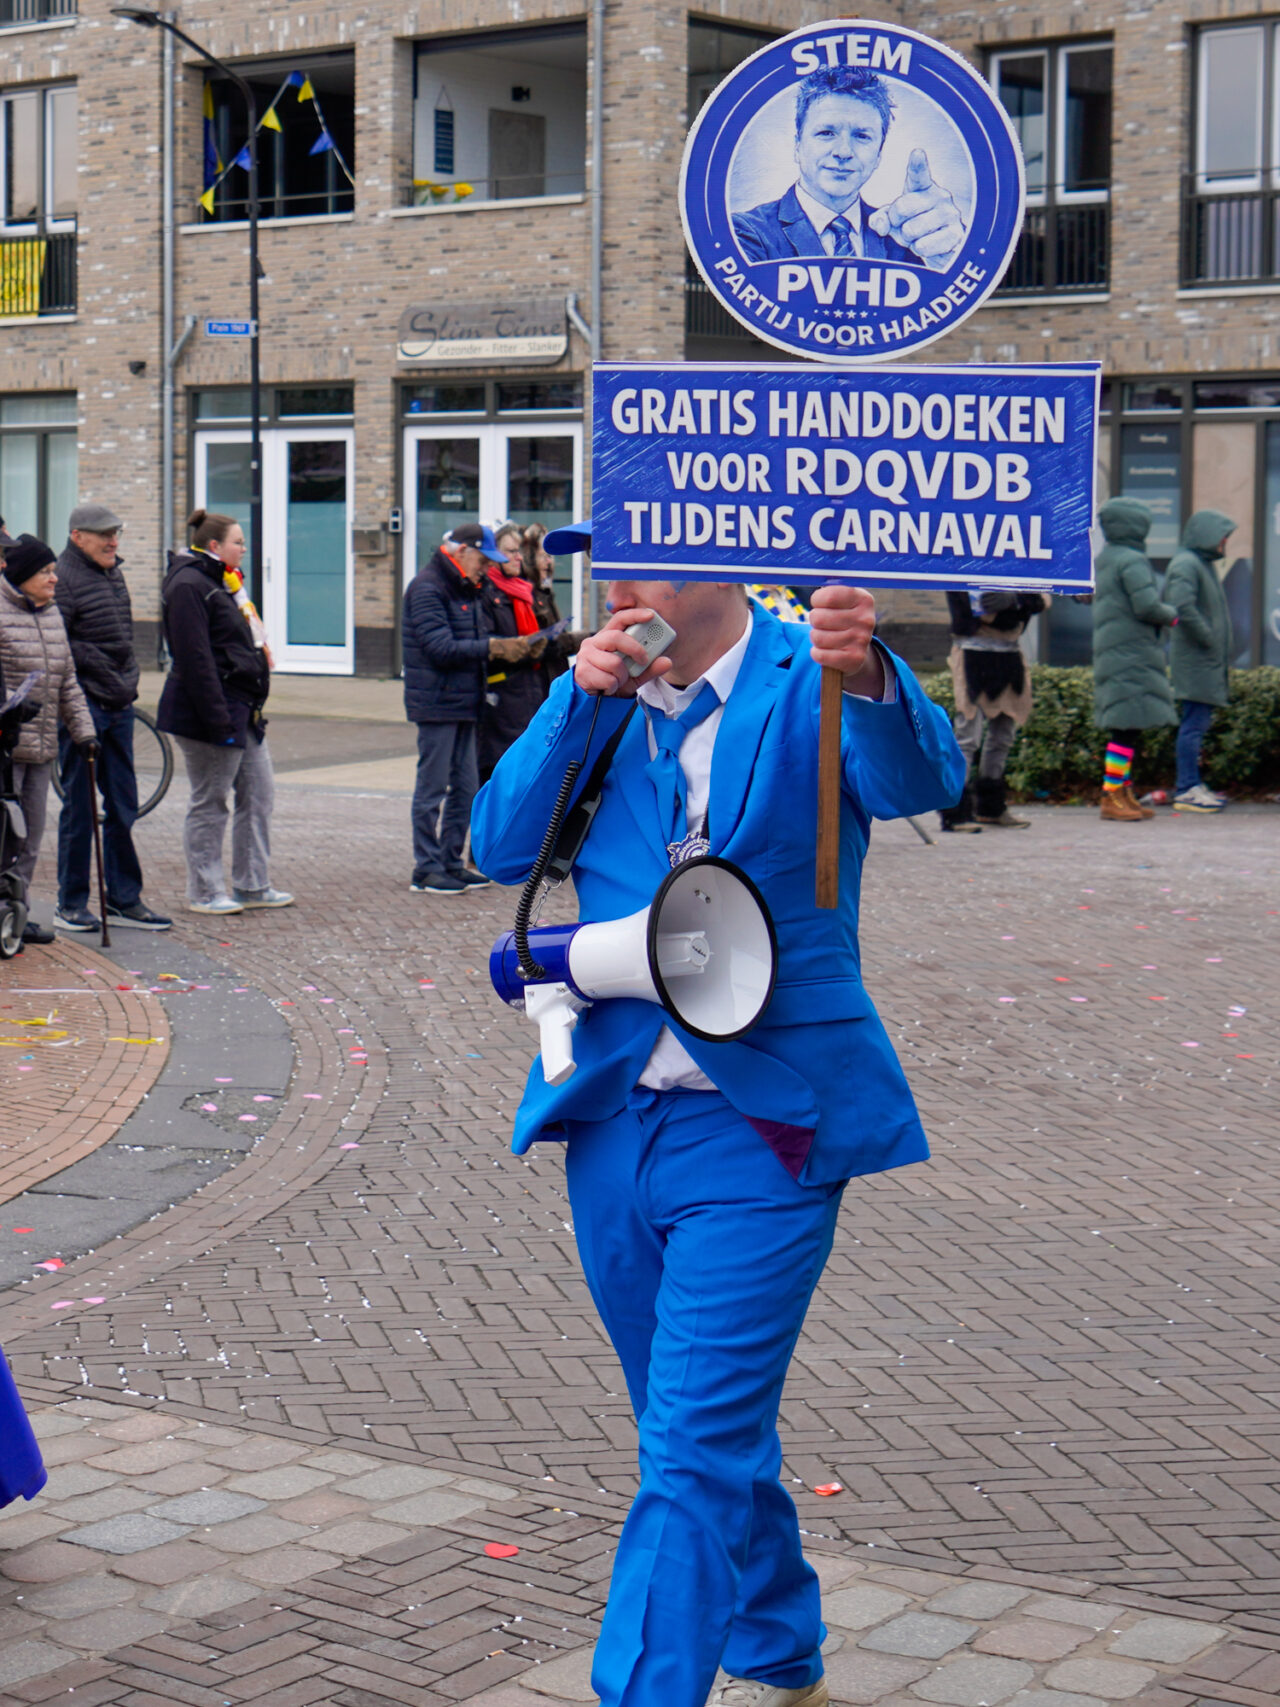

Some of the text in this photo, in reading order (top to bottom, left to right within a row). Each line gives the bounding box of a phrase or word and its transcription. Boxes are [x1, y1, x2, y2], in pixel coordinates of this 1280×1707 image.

[790, 33, 913, 76] STEM
[713, 256, 987, 346] PARTIJ VOOR HAADEEE
[777, 264, 922, 308] PVHD
[400, 308, 562, 357] Slim Time
[437, 345, 482, 357] Gezonder
[492, 343, 518, 355] Fitter
[527, 341, 563, 354] Slanker
[611, 387, 1066, 444] GRATIS HANDDOEKEN
[665, 447, 1033, 506] VOOR RDQVDB
[623, 501, 1054, 561] TIJDENS CARNAVAL
